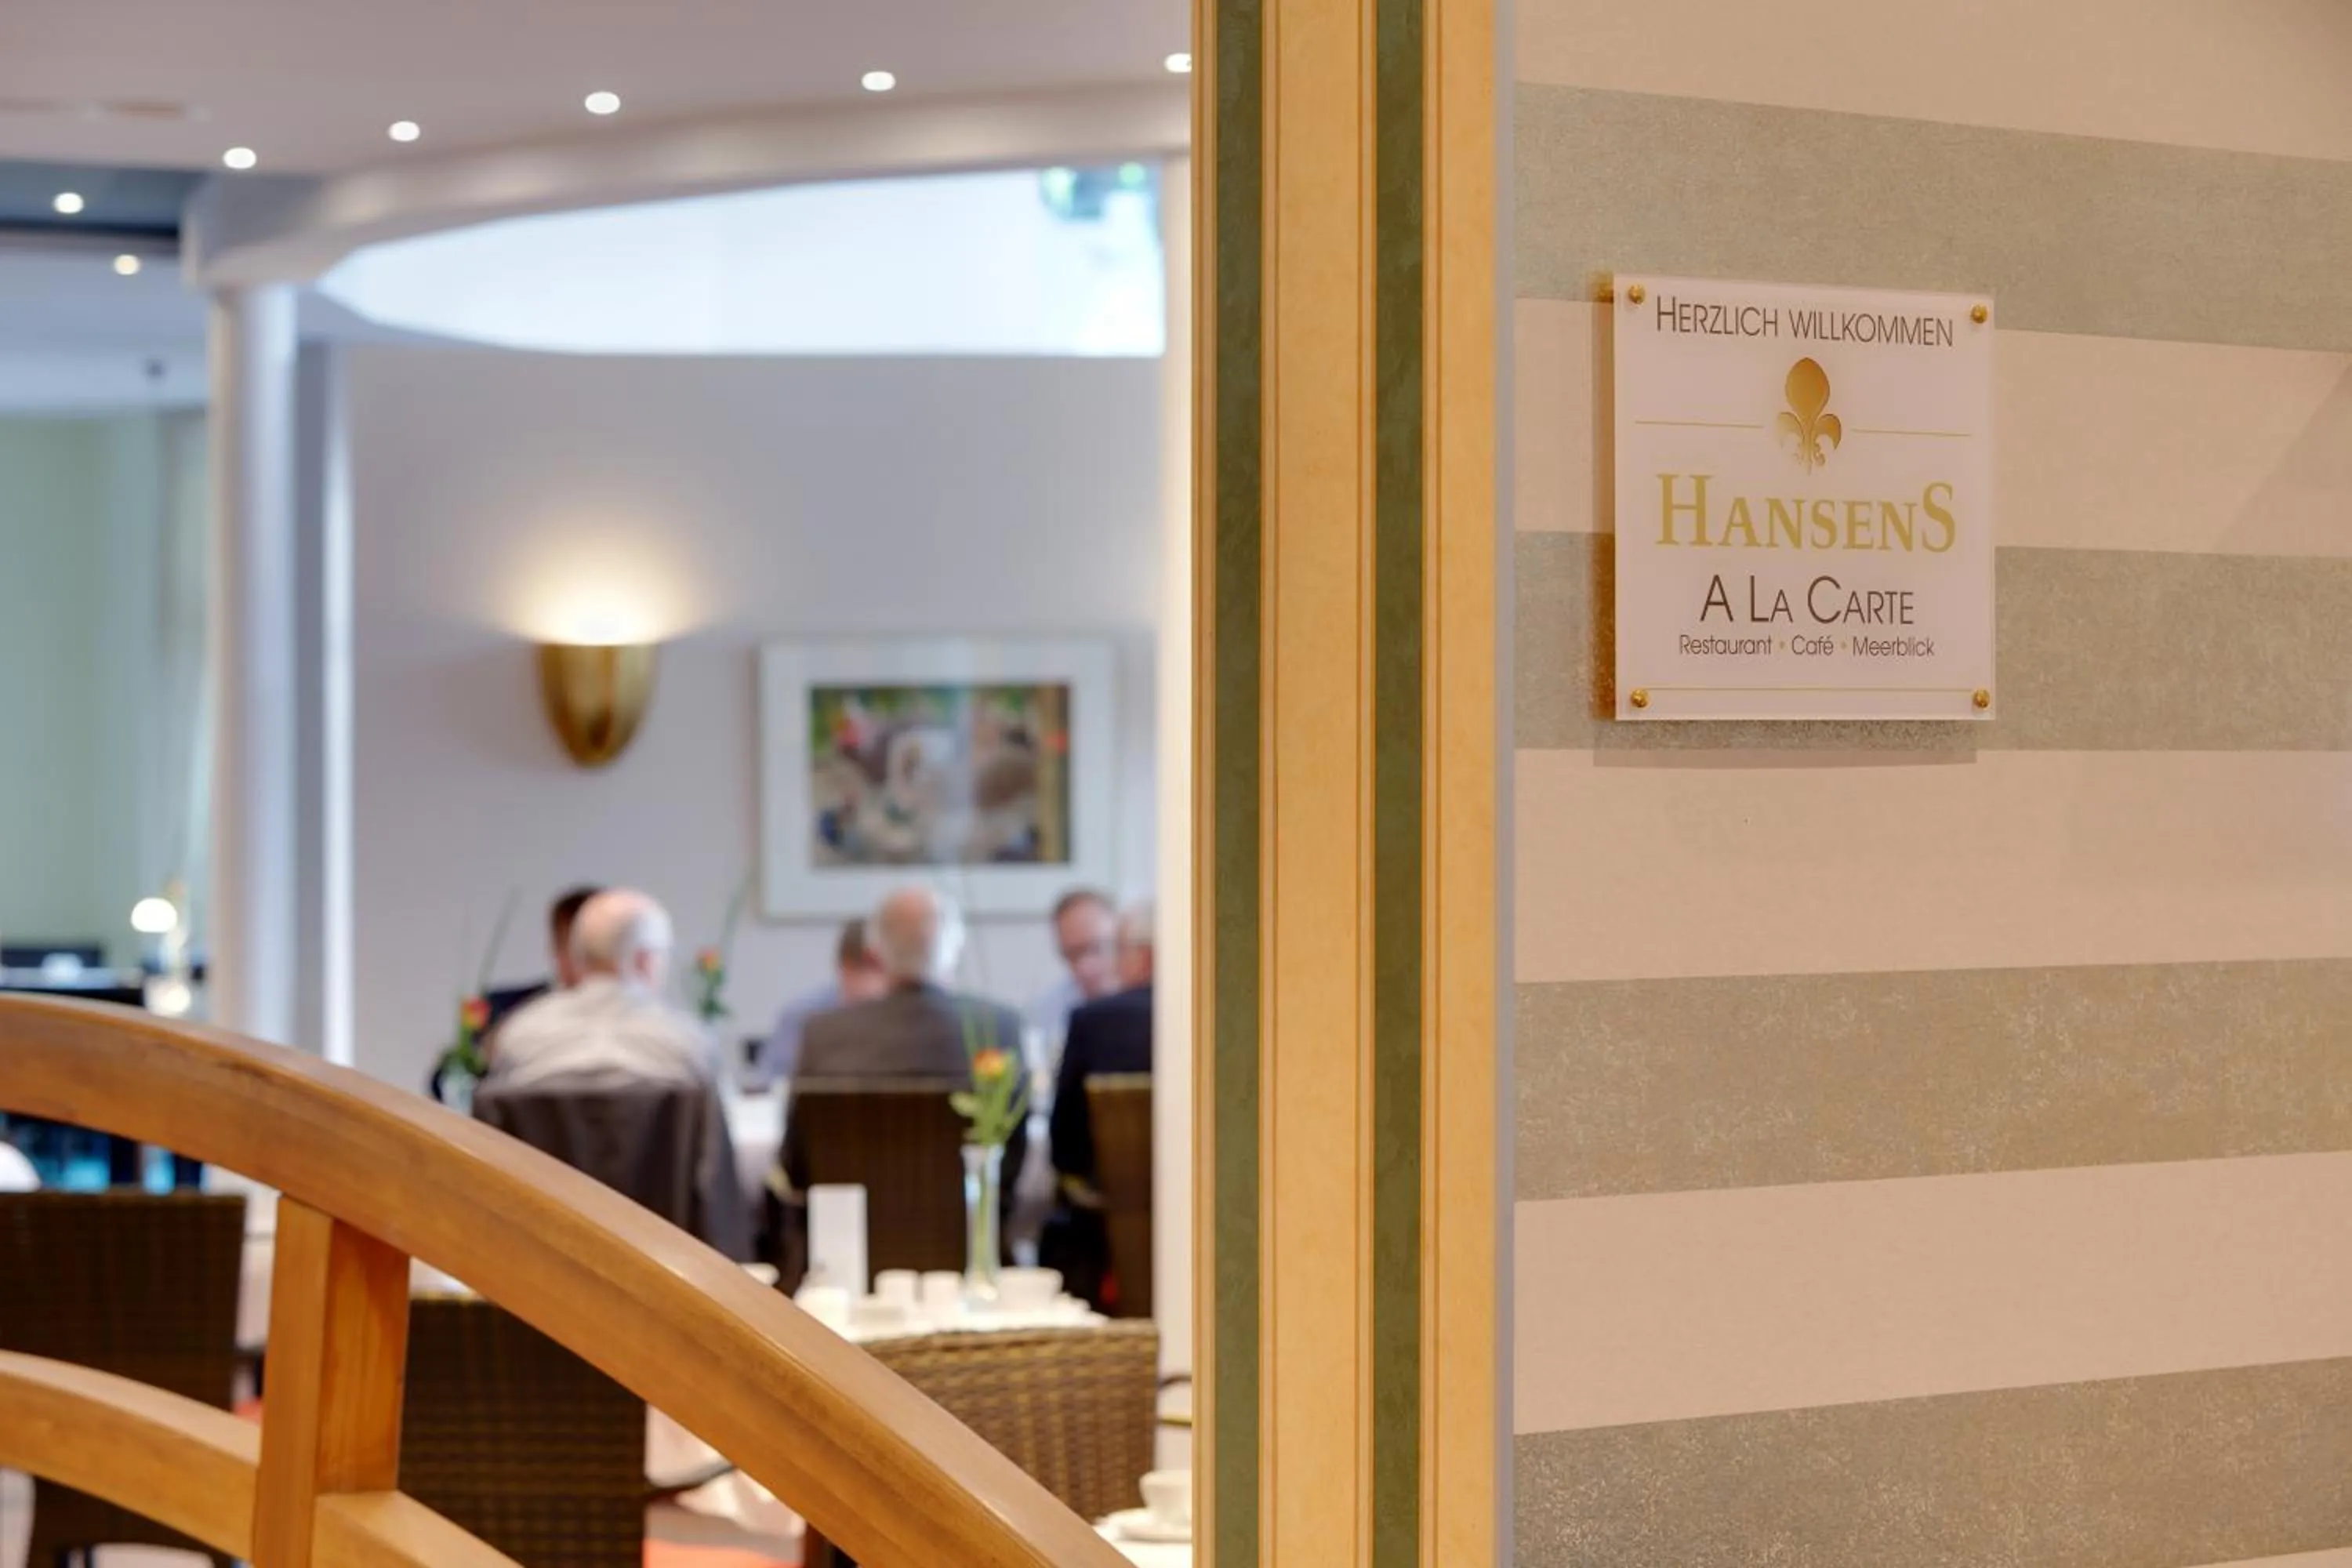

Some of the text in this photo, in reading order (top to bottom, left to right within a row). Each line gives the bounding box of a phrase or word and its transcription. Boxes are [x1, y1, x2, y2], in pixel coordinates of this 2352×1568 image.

[1657, 295, 1954, 347] HERZLICH WILLKOMMEN
[1655, 474, 1957, 554] HANSENS
[1700, 575, 1914, 626] A LA CARTE
[1679, 634, 1934, 658] Restaurant Café Meerblick
